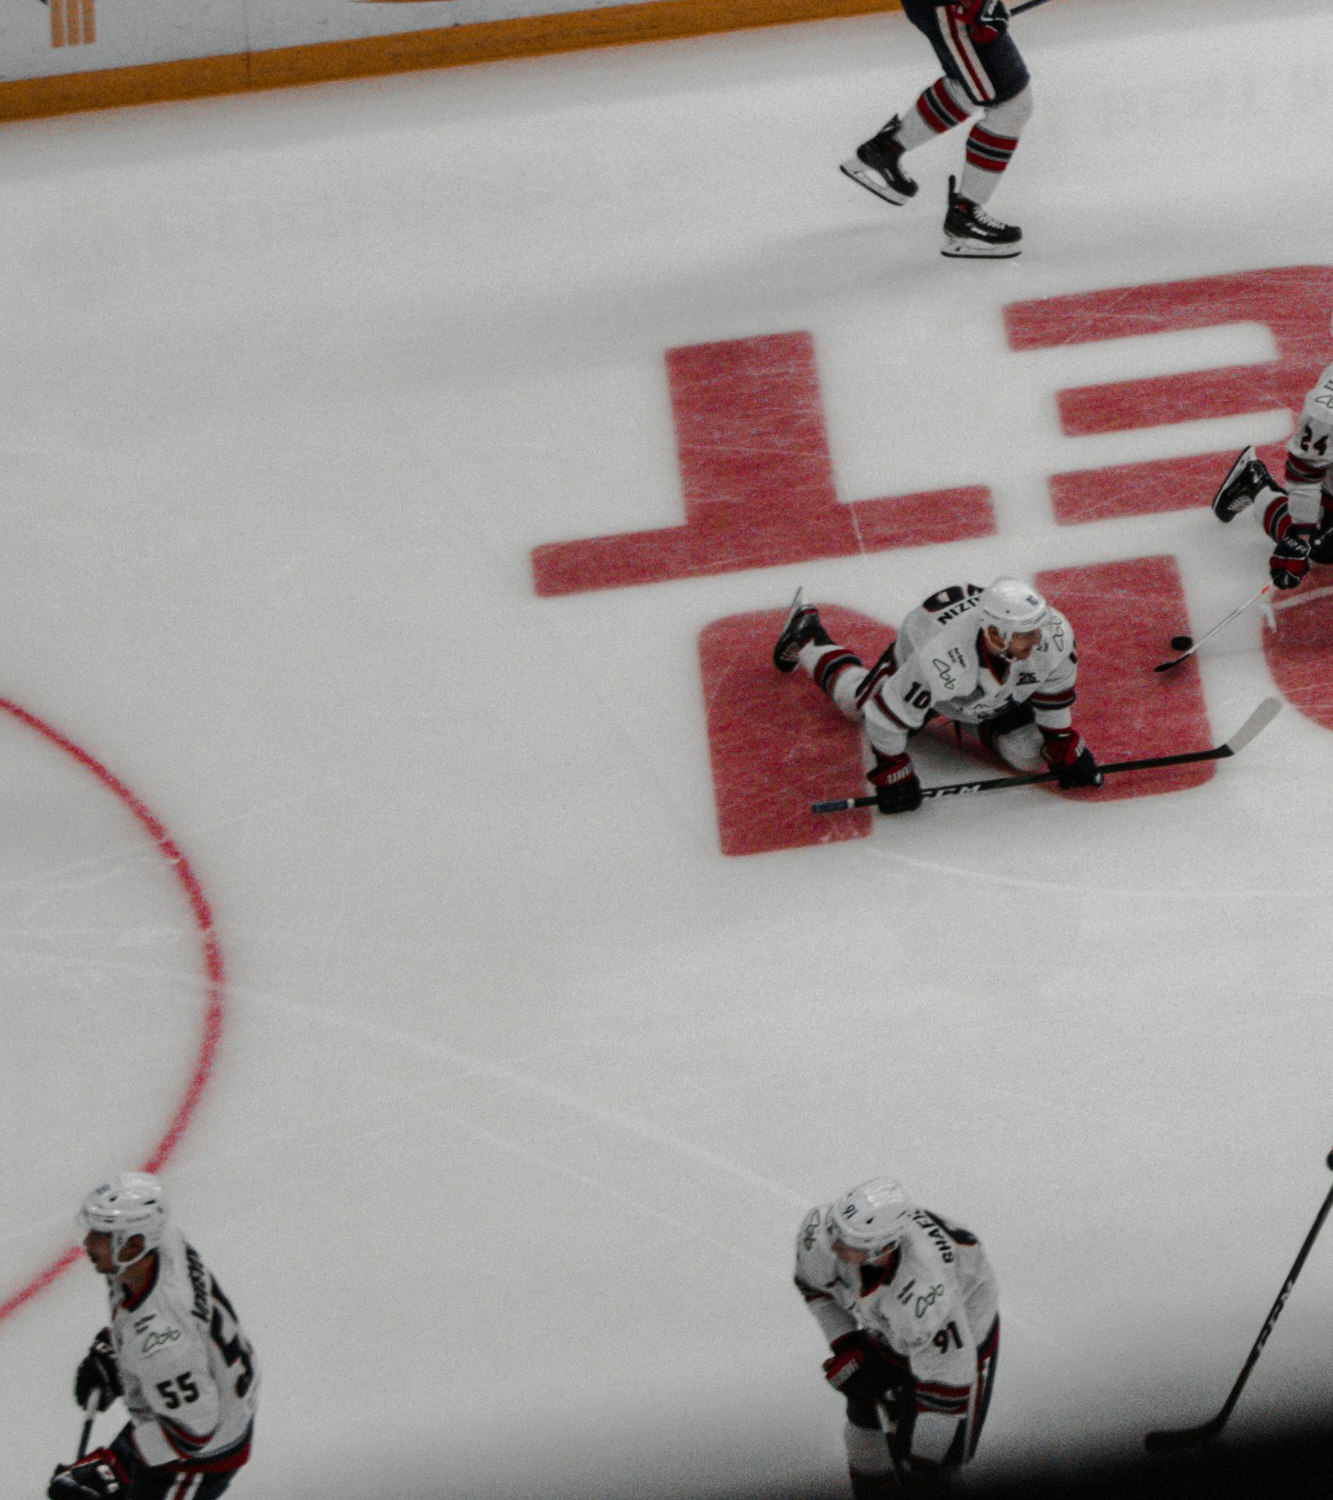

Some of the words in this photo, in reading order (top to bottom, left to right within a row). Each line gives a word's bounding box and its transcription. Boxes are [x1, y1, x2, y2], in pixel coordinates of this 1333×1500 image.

[1299, 424, 1331, 457] 24
[904, 681, 932, 710] 10
[156, 1371, 199, 1410] 55
